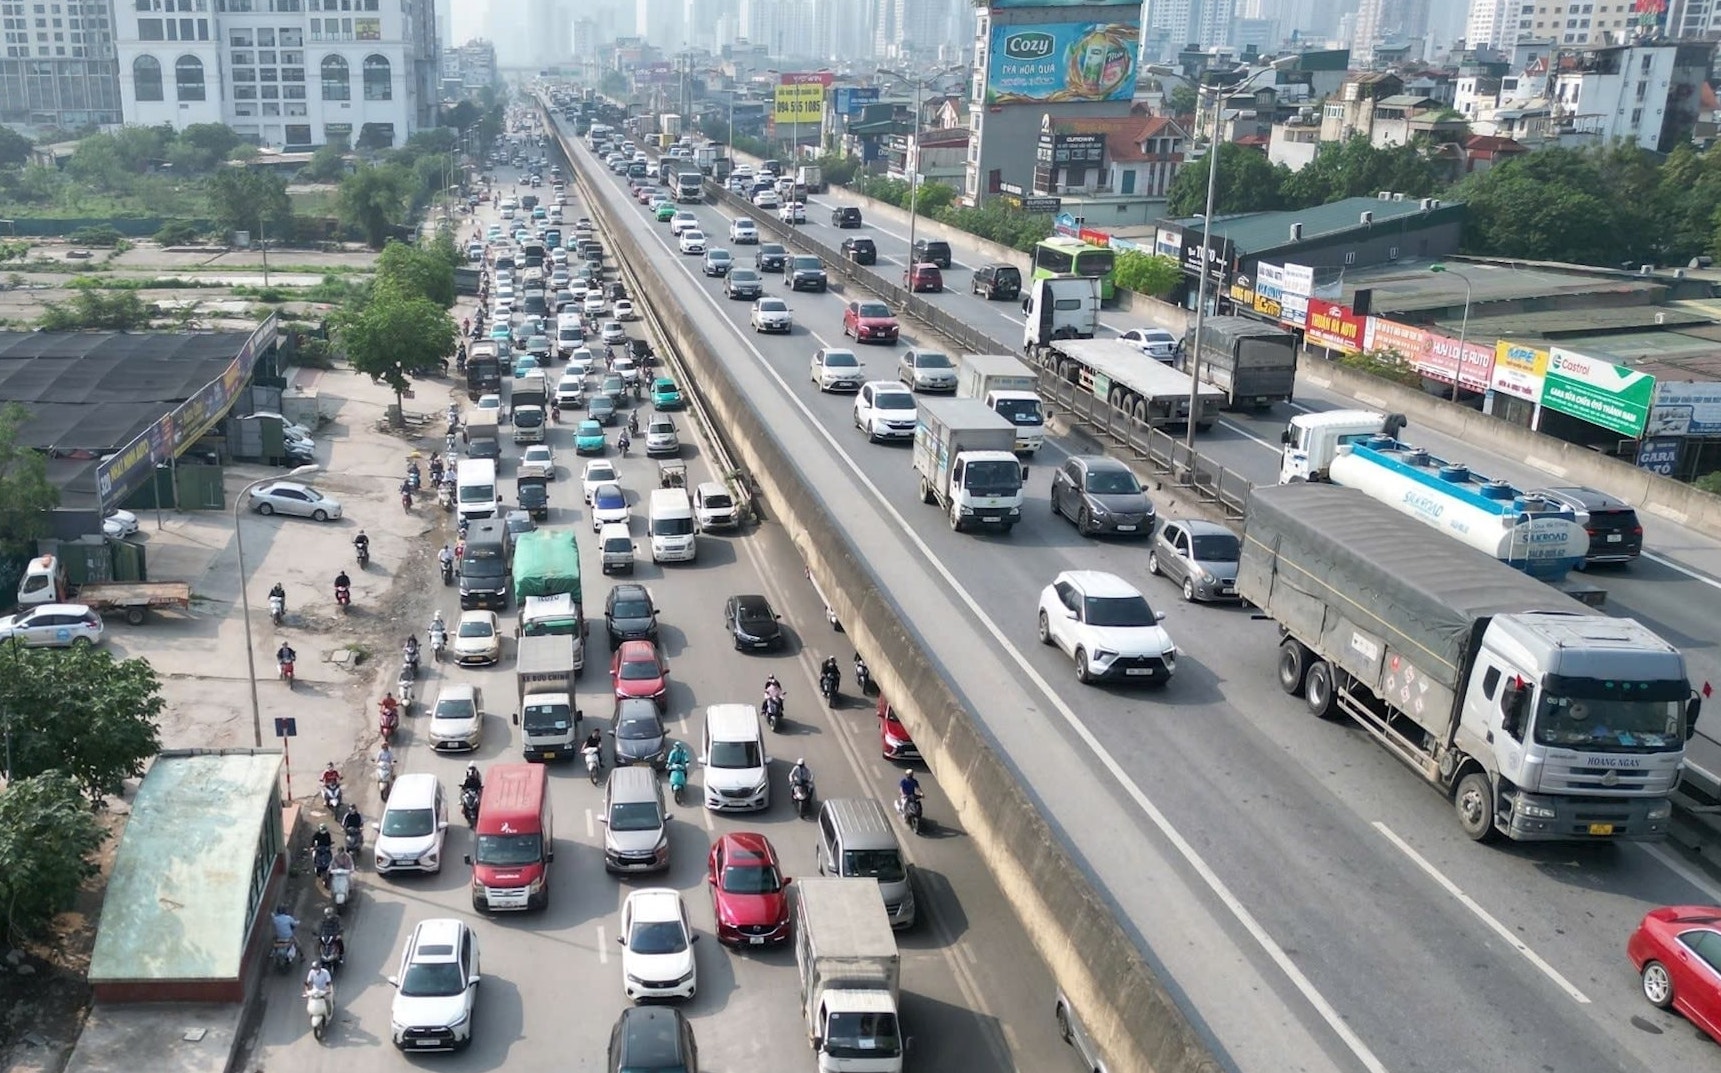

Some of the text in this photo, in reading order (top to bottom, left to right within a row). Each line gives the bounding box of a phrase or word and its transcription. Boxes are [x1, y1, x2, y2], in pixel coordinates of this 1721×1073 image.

[1010, 37, 1049, 54] Cozy
[1019, 64, 1035, 75] HOA
[1432, 340, 1448, 356] HUY
[1561, 359, 1591, 376] Castrol
[1641, 451, 1675, 462] GARA
[1522, 532, 1568, 543] SLKROAD
